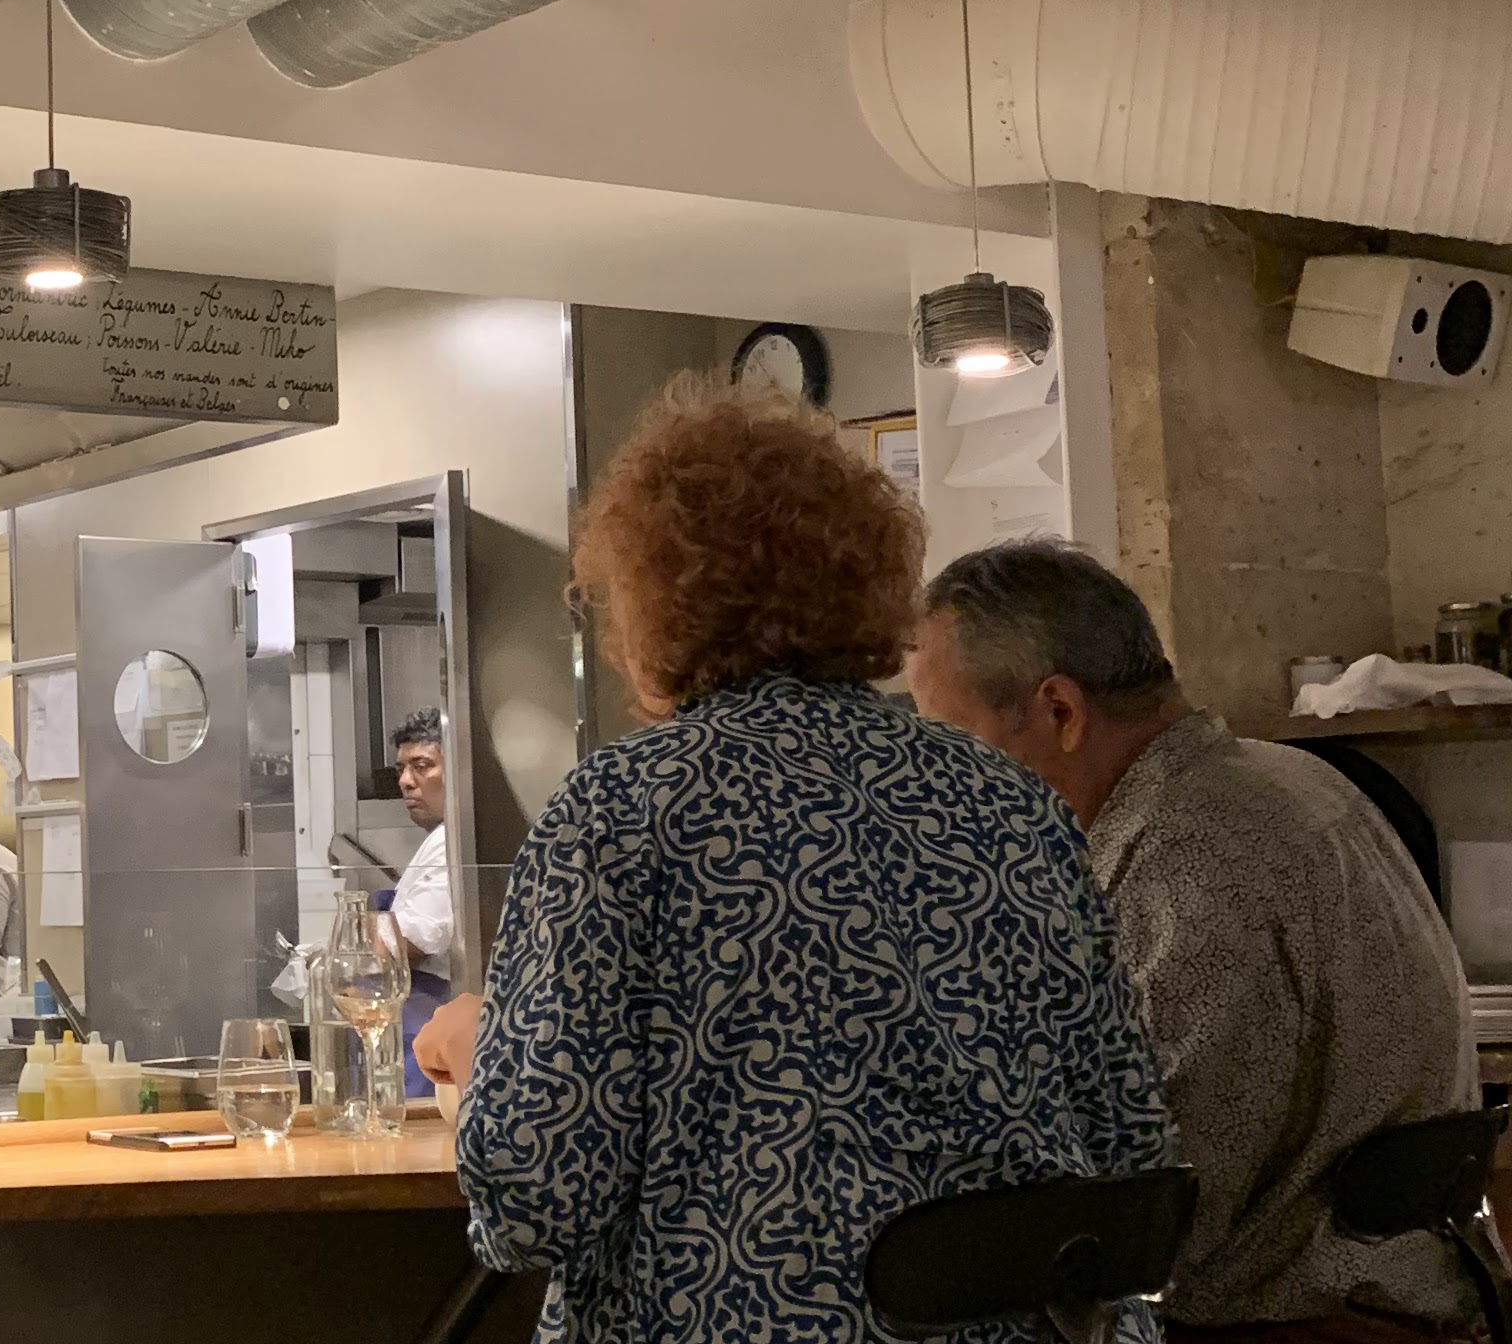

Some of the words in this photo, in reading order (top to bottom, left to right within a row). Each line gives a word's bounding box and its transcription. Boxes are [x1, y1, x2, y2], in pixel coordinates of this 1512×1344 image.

[102, 280, 176, 328] Légumes
[194, 282, 262, 322] Annie
[266, 289, 326, 327] Bertin
[96, 312, 161, 353] Poissons
[174, 318, 243, 357] Valérie
[141, 368, 166, 381] nos
[180, 387, 193, 410] et
